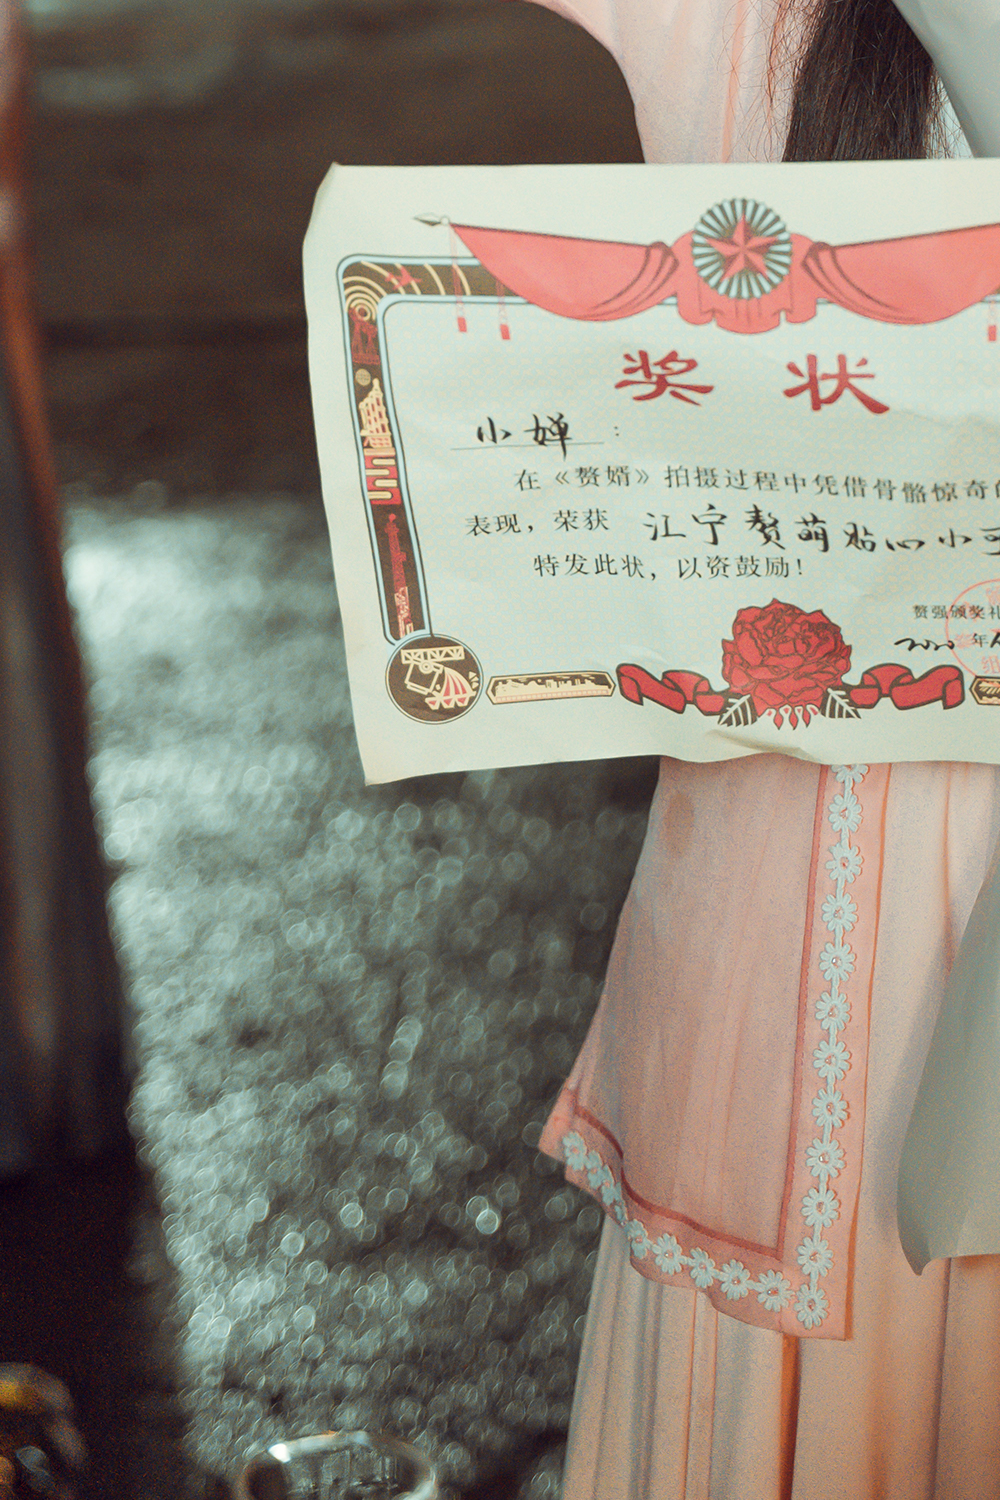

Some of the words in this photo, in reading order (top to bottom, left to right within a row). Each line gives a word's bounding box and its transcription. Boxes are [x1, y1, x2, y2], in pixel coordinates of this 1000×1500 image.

[614, 349, 890, 414] 奖状
[533, 553, 803, 581] 特发此状，以资鼓励！
